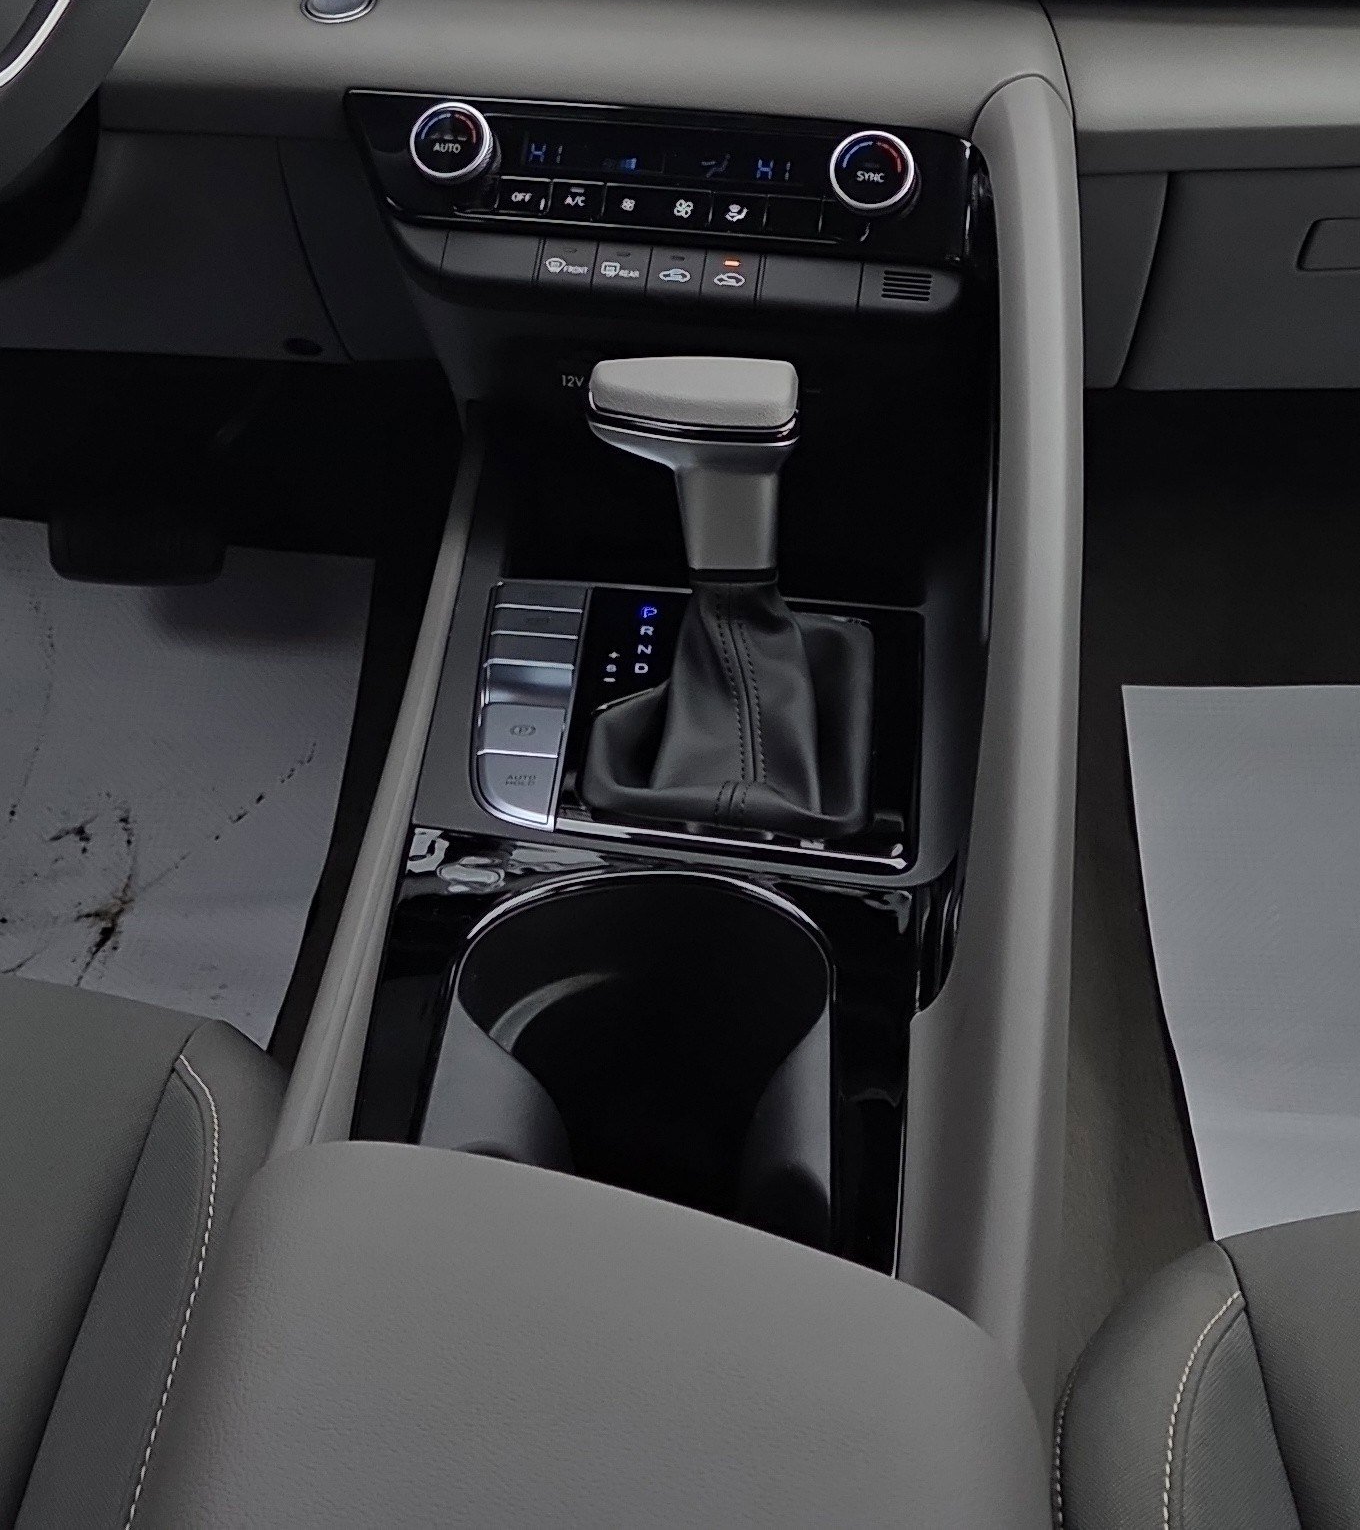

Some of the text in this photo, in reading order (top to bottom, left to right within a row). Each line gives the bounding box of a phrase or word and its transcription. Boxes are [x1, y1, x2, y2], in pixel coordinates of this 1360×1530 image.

[433, 142, 461, 154] AUTO
[855, 170, 885, 183] SYNC
[511, 191, 533, 203] OFF
[564, 194, 587, 208] A/C
[563, 264, 588, 275] FRONT
[619, 269, 640, 279] REAR
[561, 374, 585, 388] 12V
[641, 605, 658, 619] P
[640, 625, 655, 636] R
[637, 643, 653, 655] N
[634, 662, 649, 674] D
